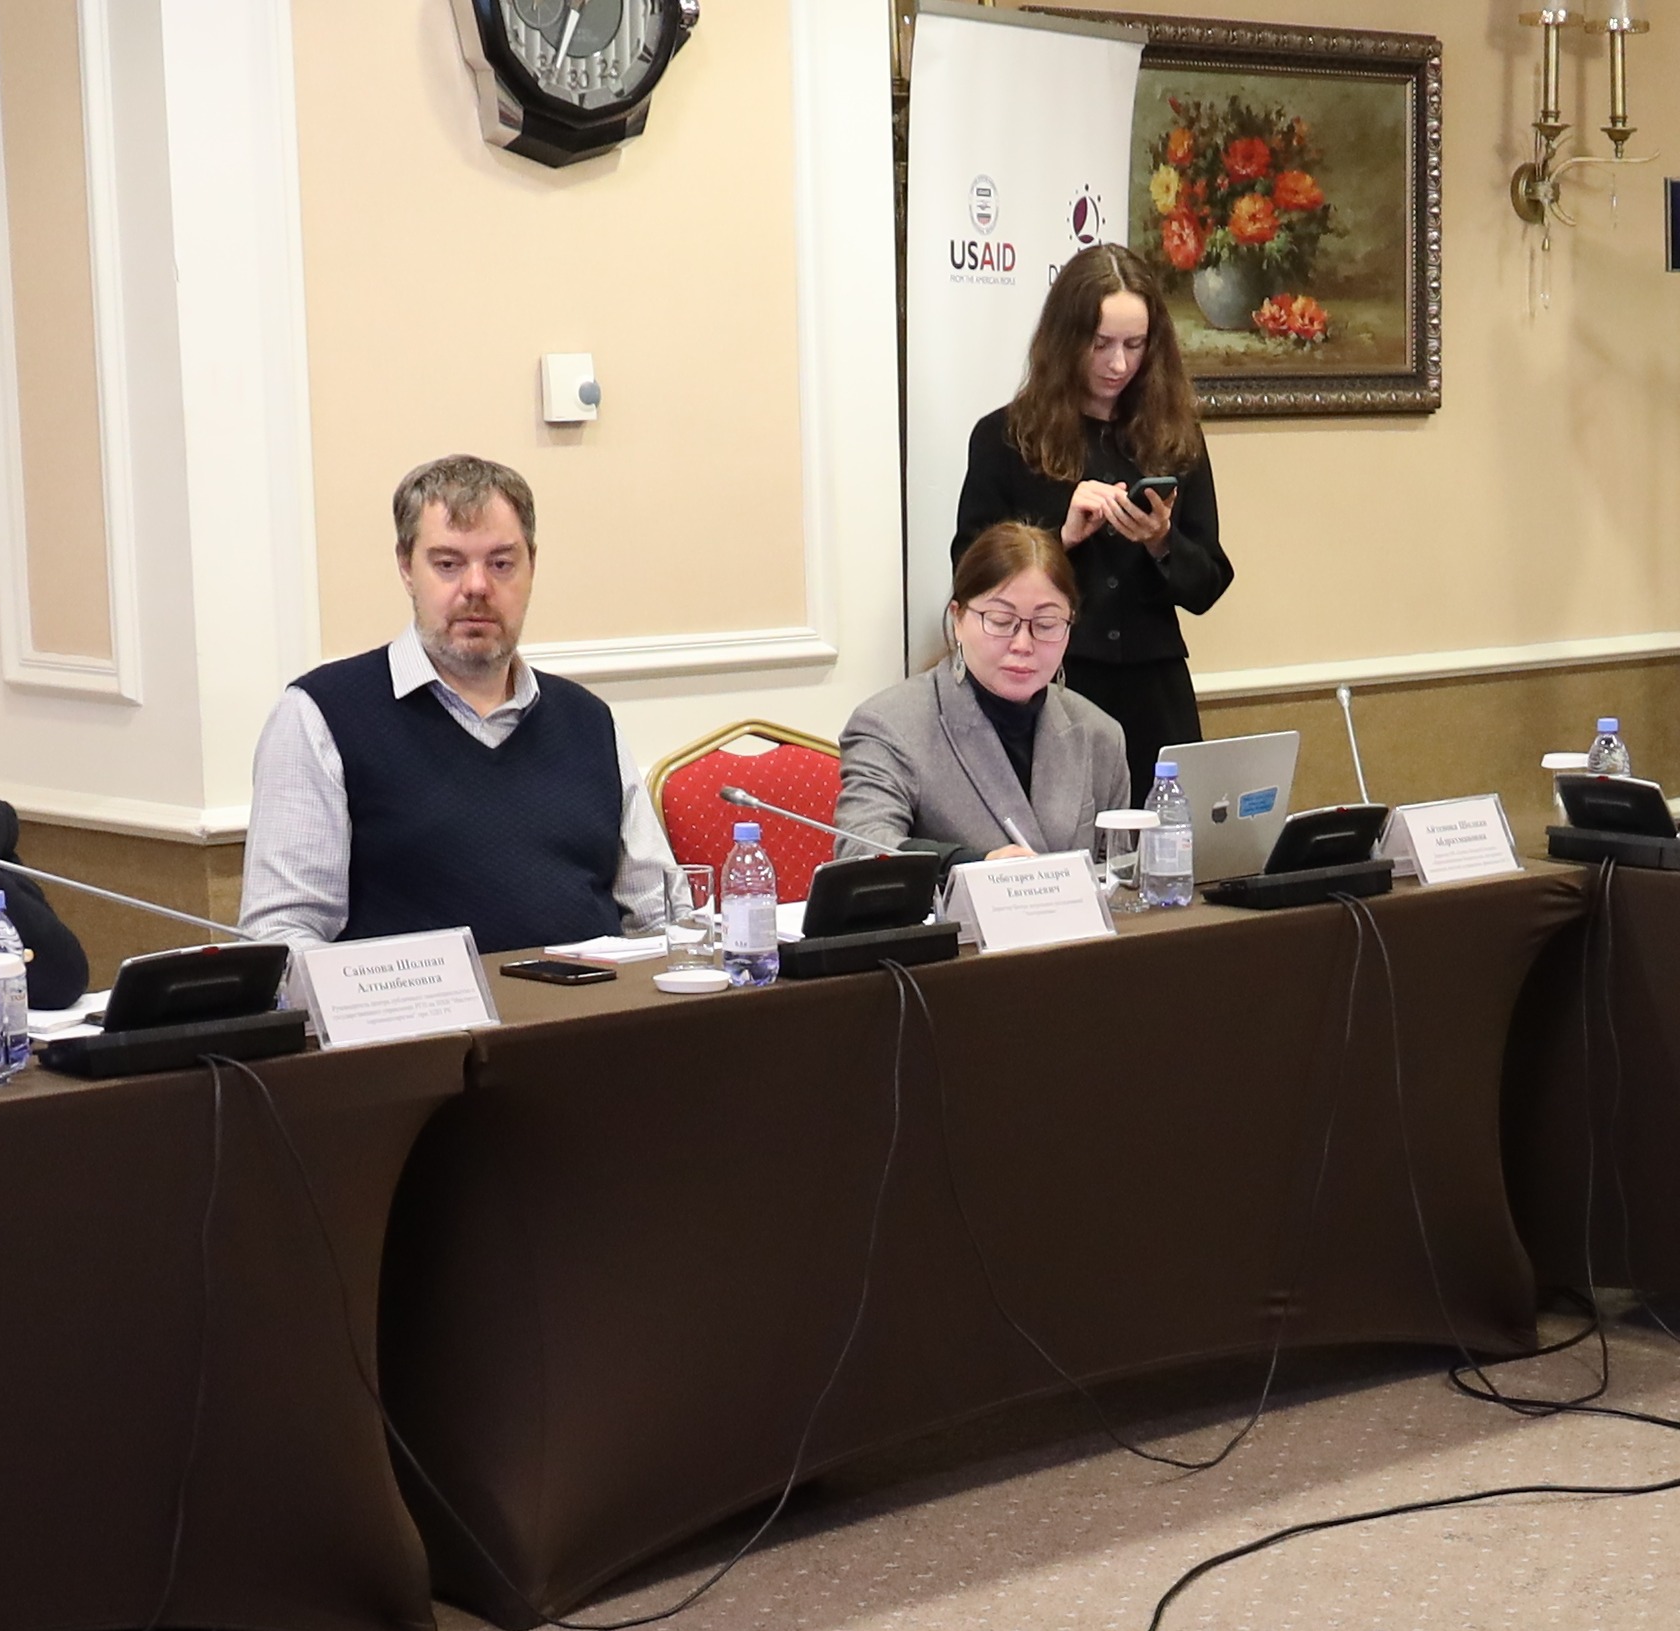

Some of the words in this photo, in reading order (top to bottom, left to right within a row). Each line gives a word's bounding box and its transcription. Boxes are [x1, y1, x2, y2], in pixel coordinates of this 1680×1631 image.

[950, 240, 1016, 272] USAID
[1037, 867, 1071, 881] Андрей
[342, 961, 394, 978] Саймова
[396, 956, 445, 973] Шолпан
[357, 974, 443, 994] Алтынбековна
